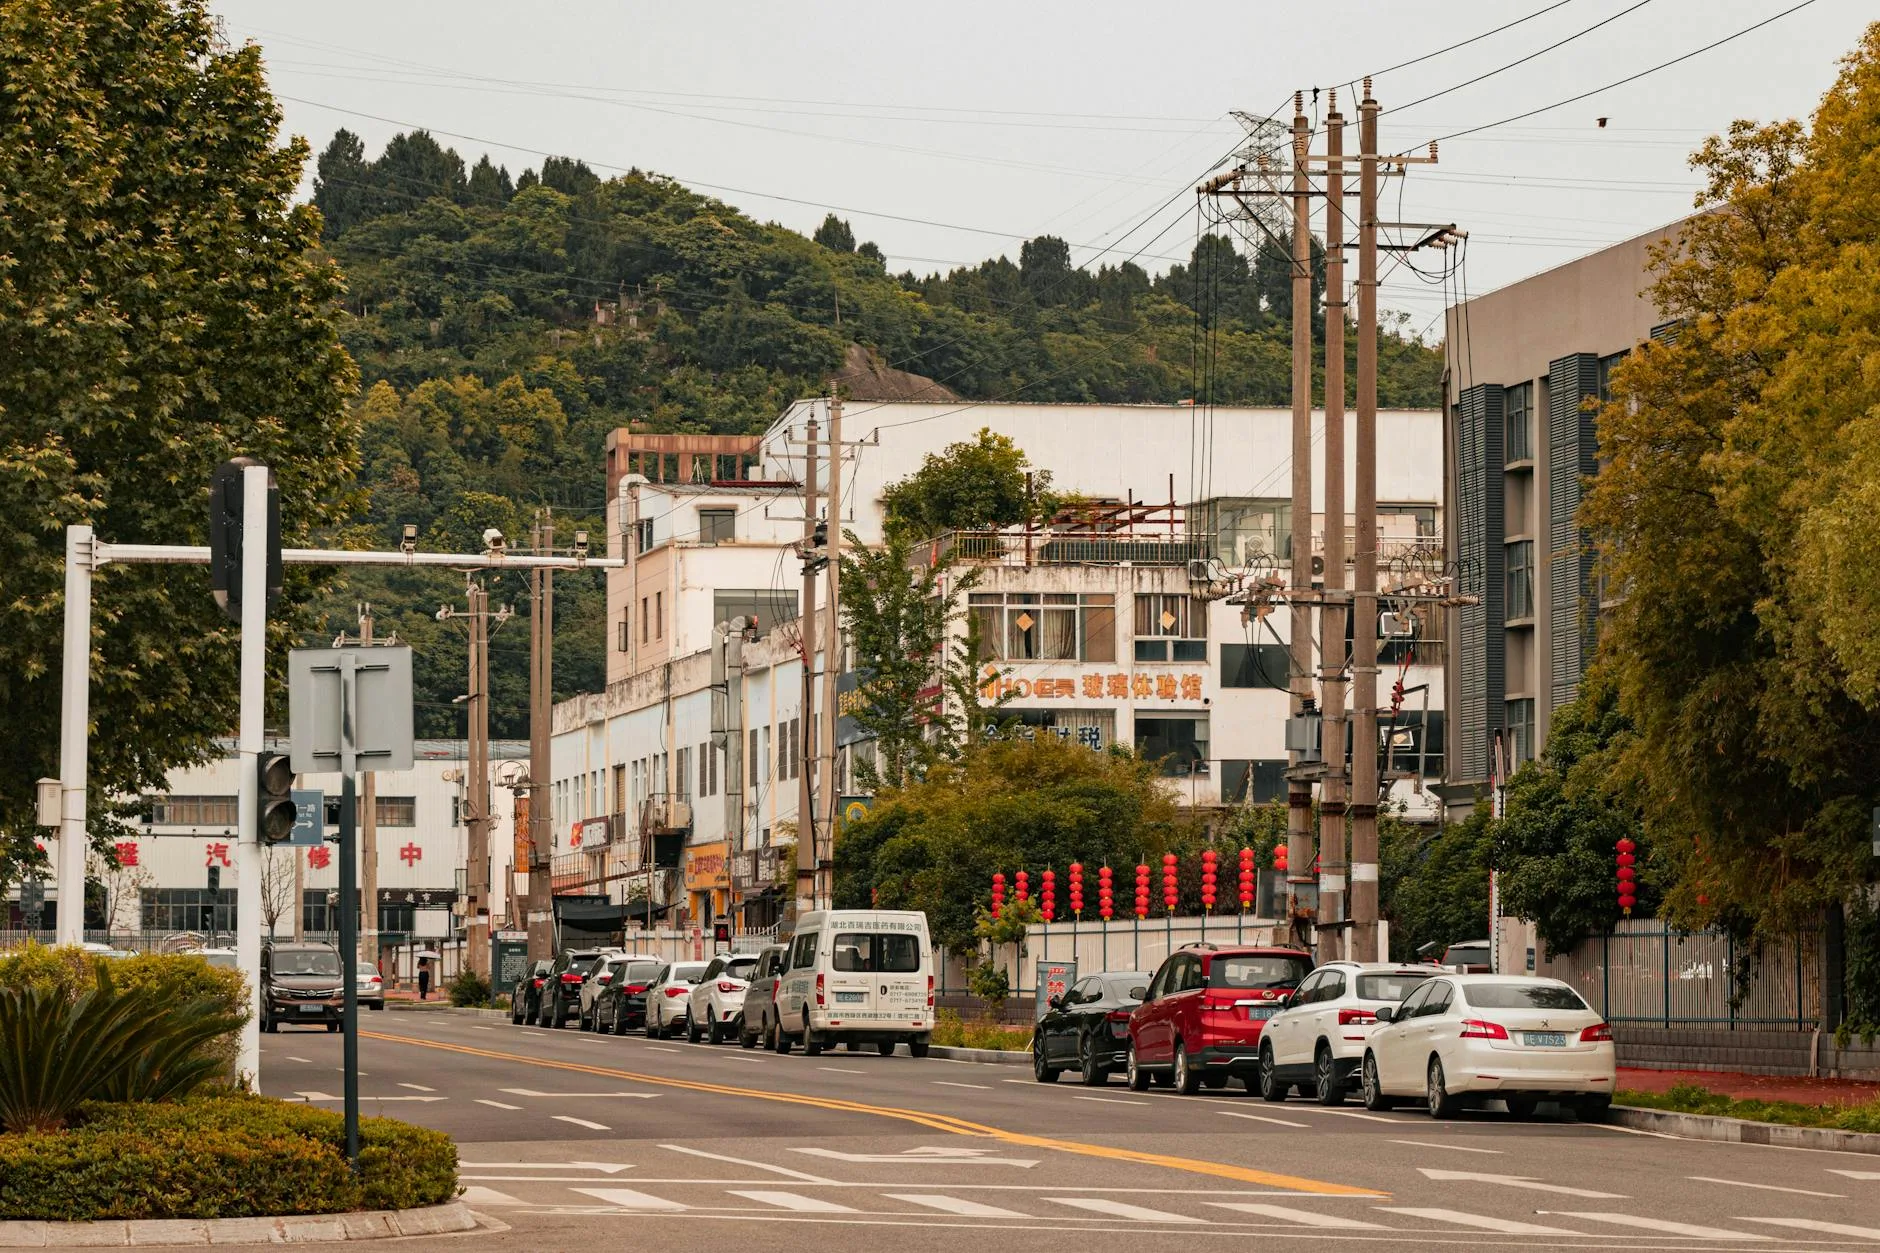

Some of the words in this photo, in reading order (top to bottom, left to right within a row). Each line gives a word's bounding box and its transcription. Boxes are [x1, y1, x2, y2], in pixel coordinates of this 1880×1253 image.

[1081, 672, 1203, 700] 玻璃体验馆
[296, 803, 316, 813] 一路
[1046, 966, 1067, 1008] 严禁
